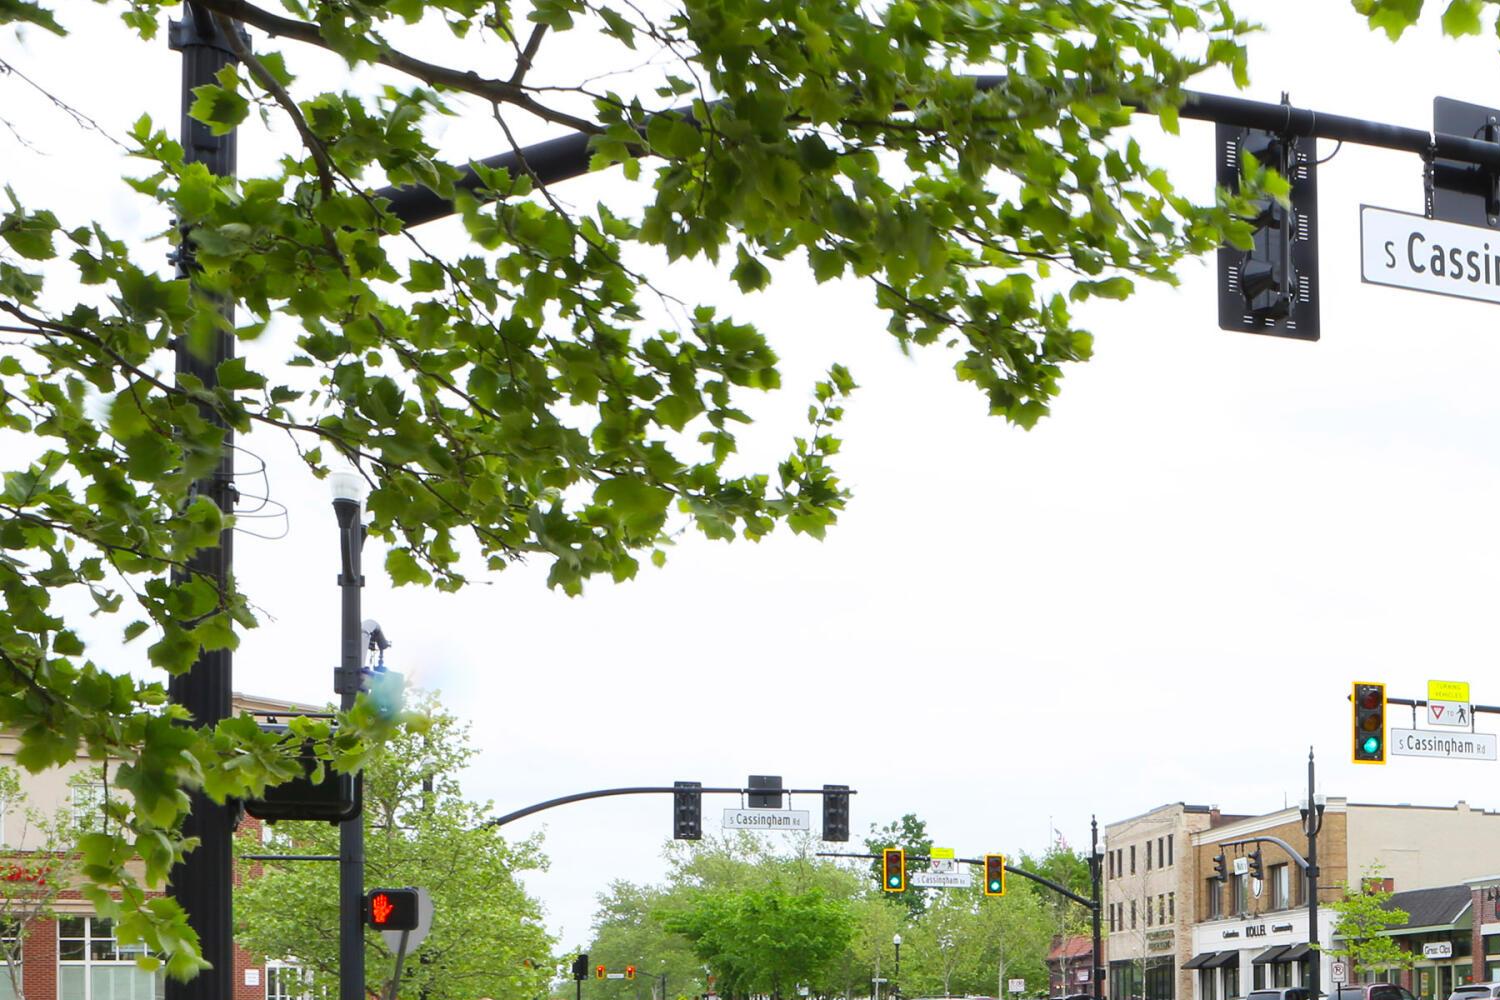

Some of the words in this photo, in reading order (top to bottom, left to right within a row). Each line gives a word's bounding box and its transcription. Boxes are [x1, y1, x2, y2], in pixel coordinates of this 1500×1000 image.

[1384, 241, 1396, 269] S
[1399, 739, 1404, 750] S
[1407, 735, 1474, 755] Cassingham
[1476, 744, 1486, 754] Rd
[736, 813, 790, 829] Cassingham
[922, 875, 959, 885] Cassingham
